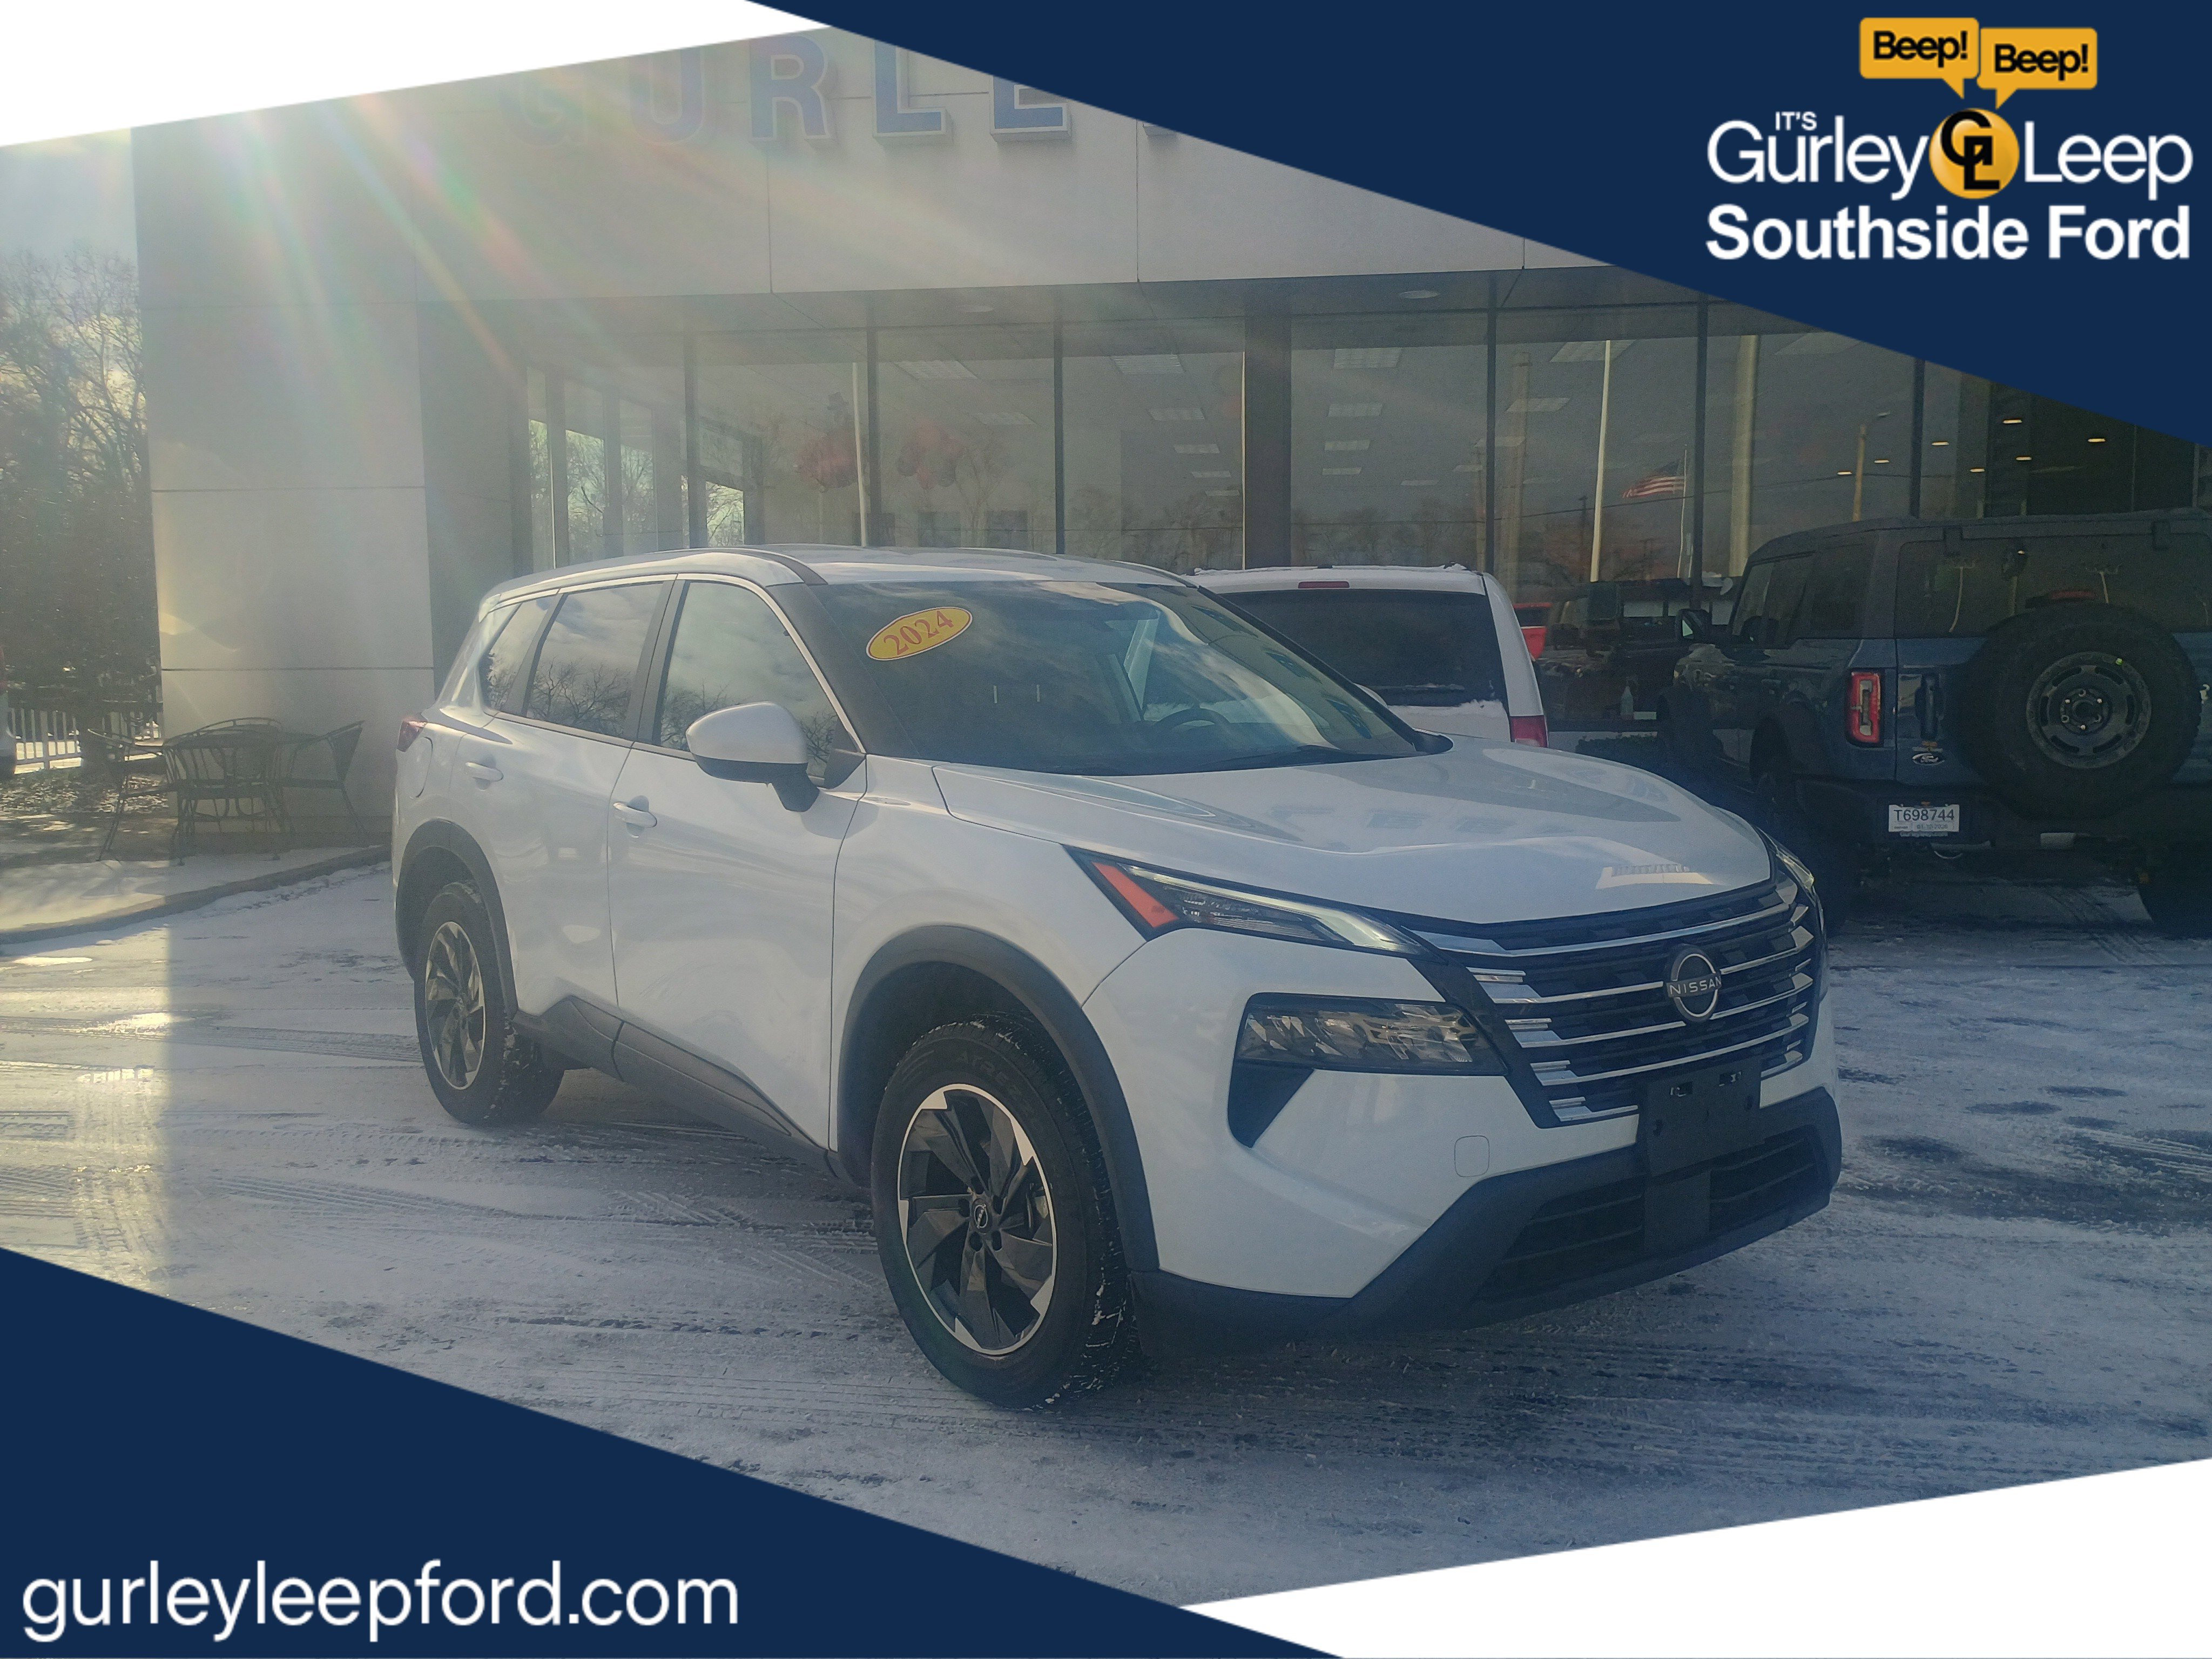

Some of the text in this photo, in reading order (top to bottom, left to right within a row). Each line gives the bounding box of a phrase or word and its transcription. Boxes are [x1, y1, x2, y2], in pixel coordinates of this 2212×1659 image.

[883, 610, 955, 656] 2024
[1893, 809, 1955, 821] T698744
[1669, 975, 1722, 995] NISSAN
